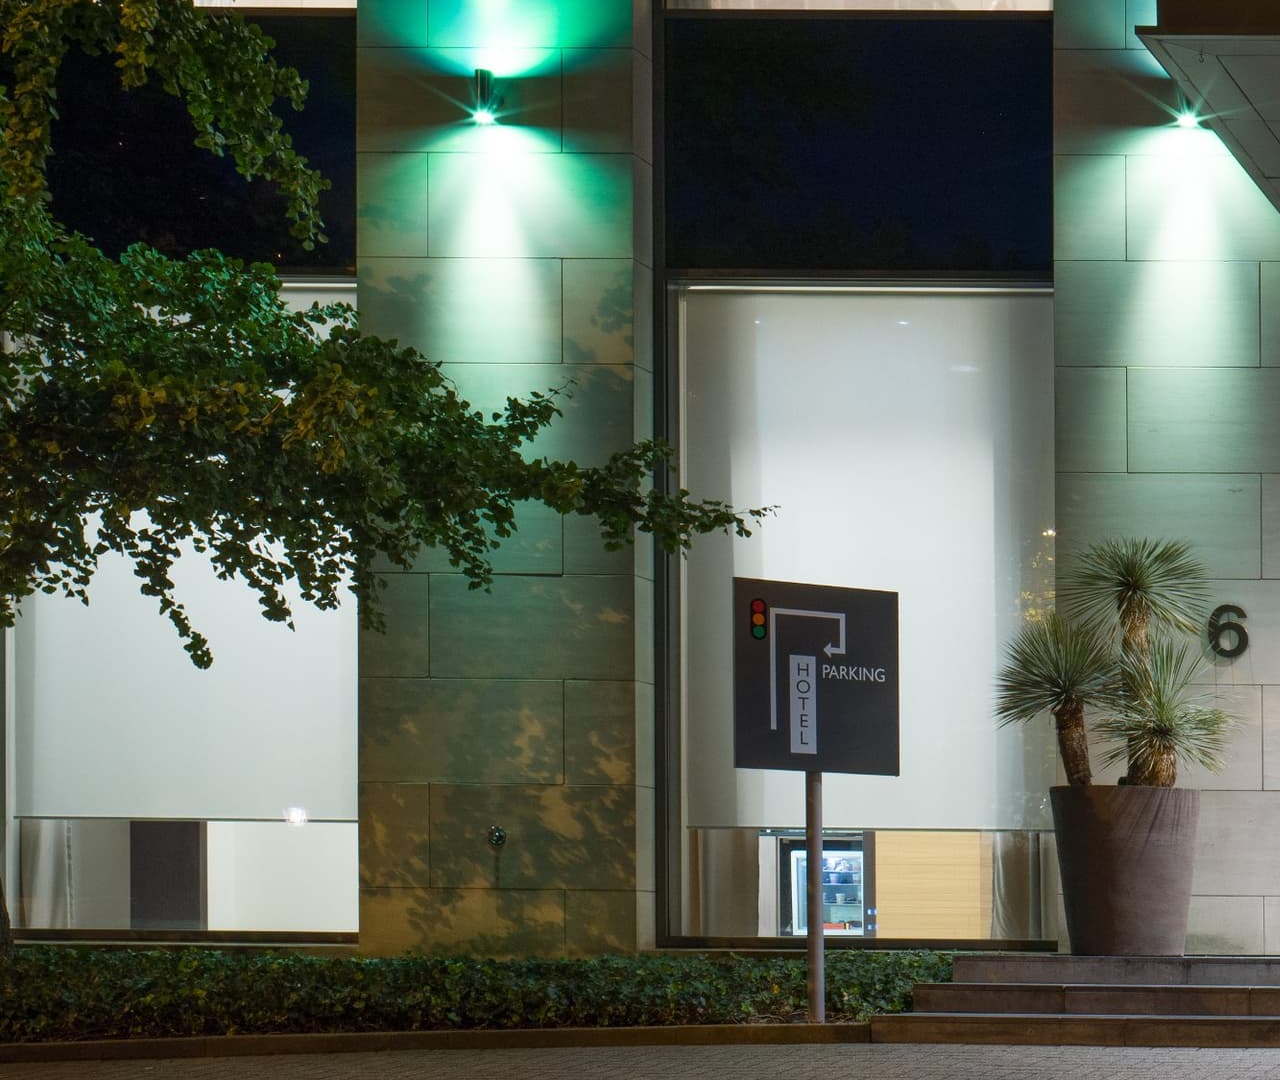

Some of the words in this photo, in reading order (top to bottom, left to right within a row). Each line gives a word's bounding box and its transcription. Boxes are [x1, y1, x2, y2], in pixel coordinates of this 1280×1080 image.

[1207, 604, 1249, 658] 6
[822, 664, 886, 682] PARKING
[797, 663, 810, 745] HOTEL
